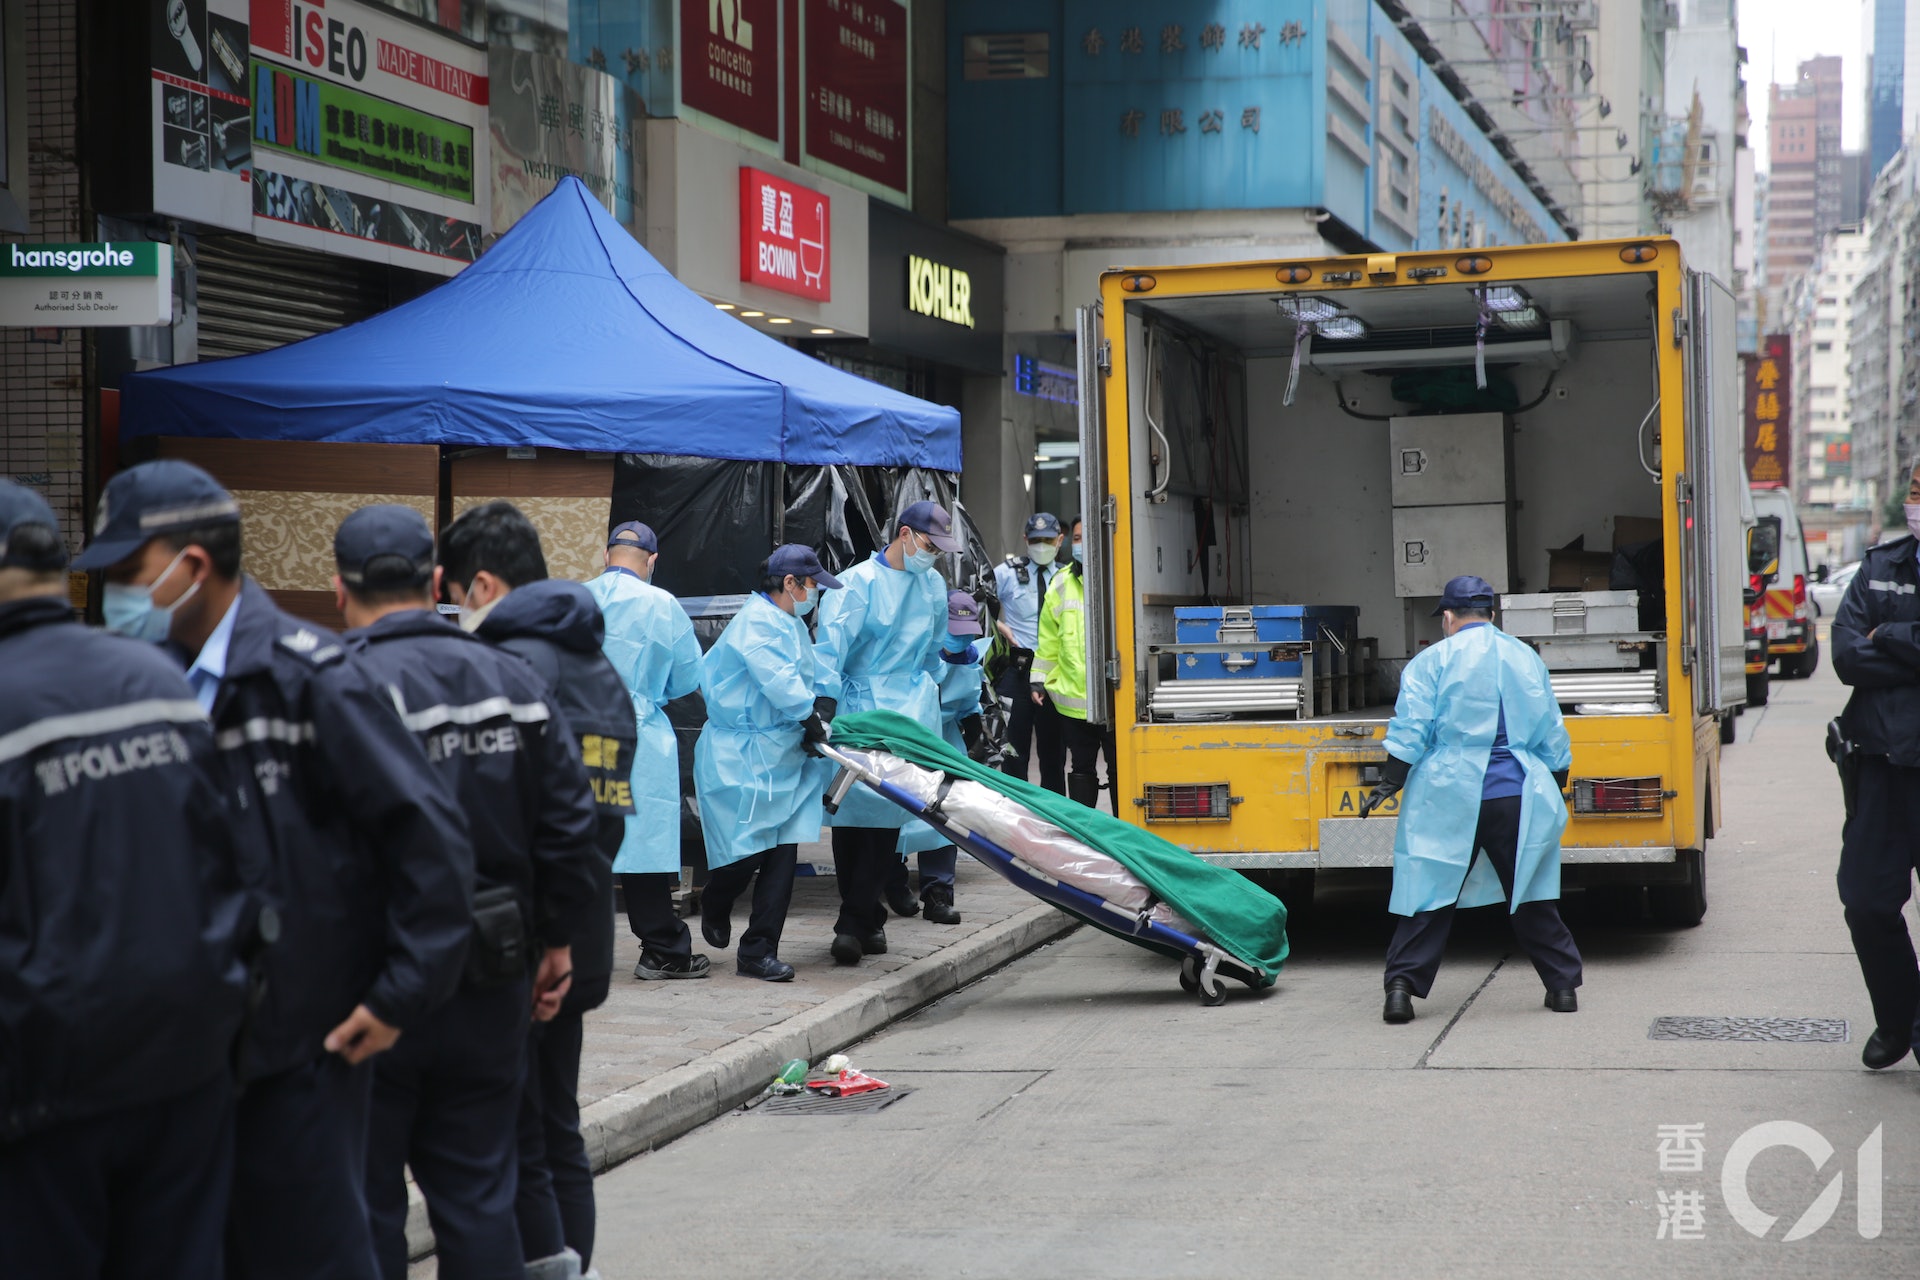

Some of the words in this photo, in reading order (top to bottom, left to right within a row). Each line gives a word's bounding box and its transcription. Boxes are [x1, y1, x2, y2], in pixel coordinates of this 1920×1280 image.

[293, 5, 367, 82] ISEO
[1083, 20, 1307, 55] 香港裝飾材料
[377, 40, 417, 83] MADE
[422, 58, 436, 90] IN
[441, 64, 473, 100] ITALY
[708, 41, 752, 78] concetto
[256, 65, 320, 156] ADM
[1120, 105, 1261, 137] 有限公司
[523, 159, 552, 179] WAH
[761, 184, 794, 239] 寶盈
[12, 242, 133, 271] hansgrohe
[759, 241, 797, 280] BOWIN
[34, 303, 75, 312] Authorised
[77, 303, 91, 311] Sub
[93, 303, 118, 311] Dealer
[49, 290, 104, 300] 認可分銷商
[909, 254, 972, 328] KOHLER
[64, 731, 173, 787] POLICE
[442, 726, 519, 758] PLICE
[589, 777, 633, 807] LICE
